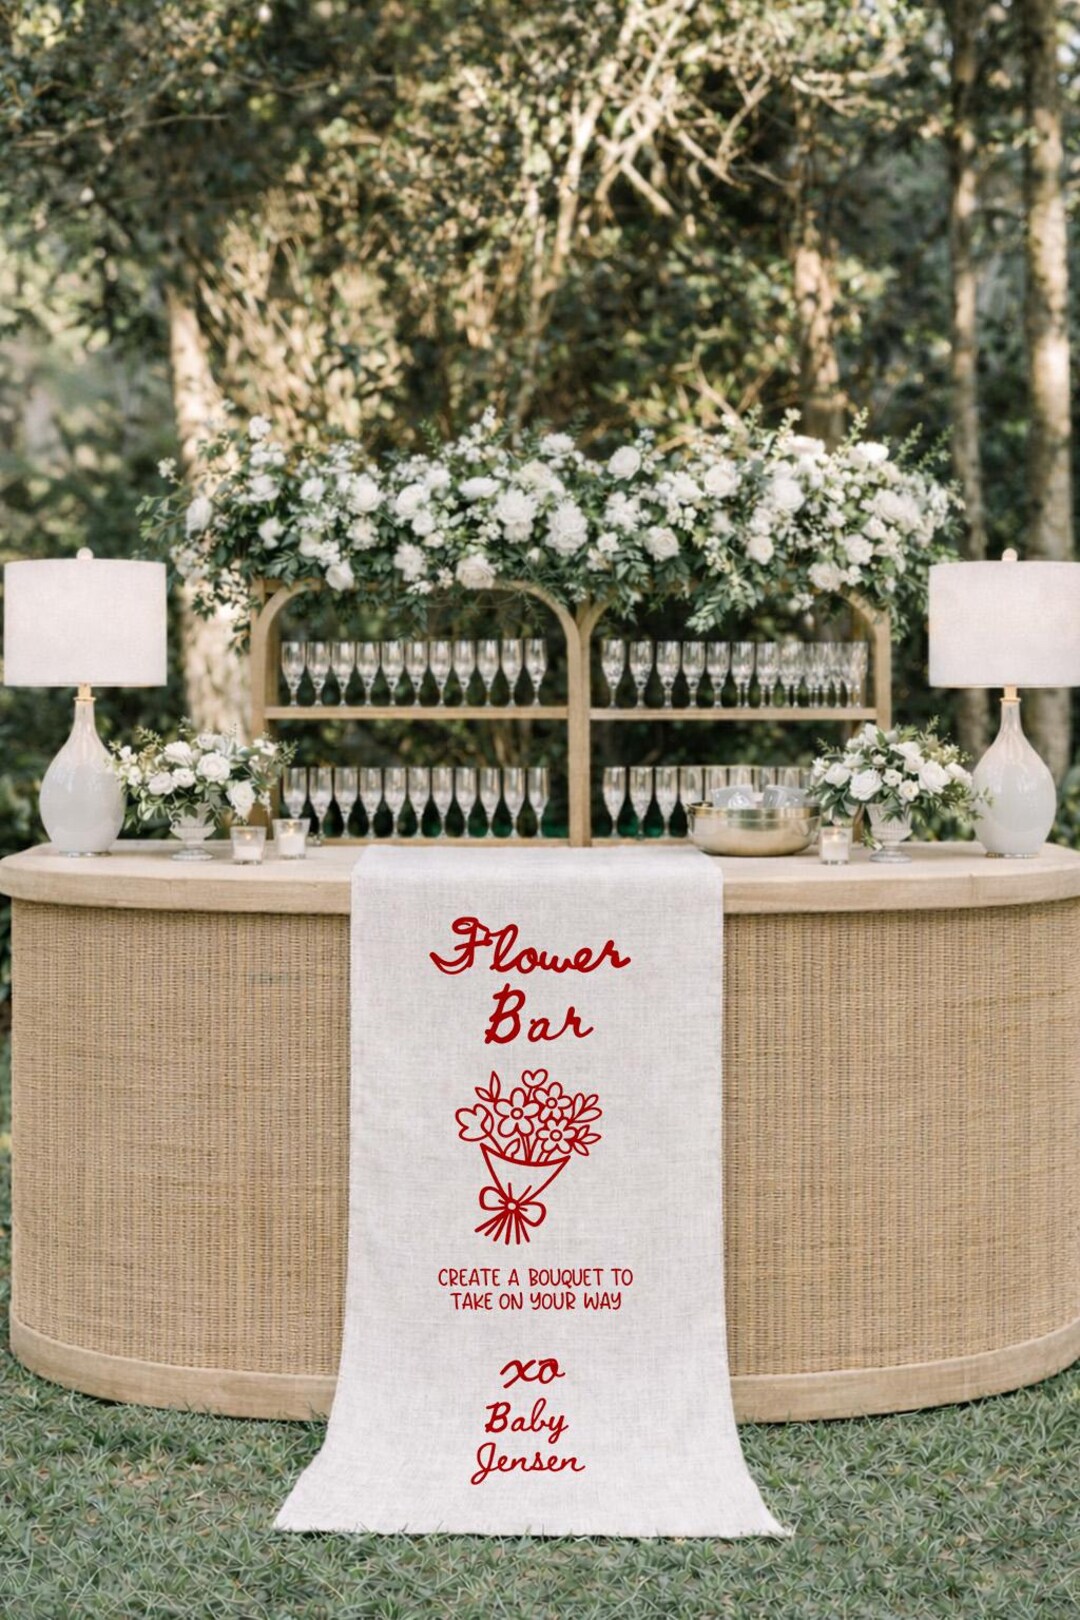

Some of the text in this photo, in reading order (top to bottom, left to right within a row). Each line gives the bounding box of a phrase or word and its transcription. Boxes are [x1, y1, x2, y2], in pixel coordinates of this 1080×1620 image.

[429, 916, 632, 975] Flower
[484, 983, 594, 1044] Bar
[438, 1267, 634, 1289] CREATE A BOUQUET TO
[450, 1291, 622, 1311] TAKE ON YOUR WAY
[484, 1397, 569, 1444] Baby
[470, 1442, 586, 1485] Jensen
